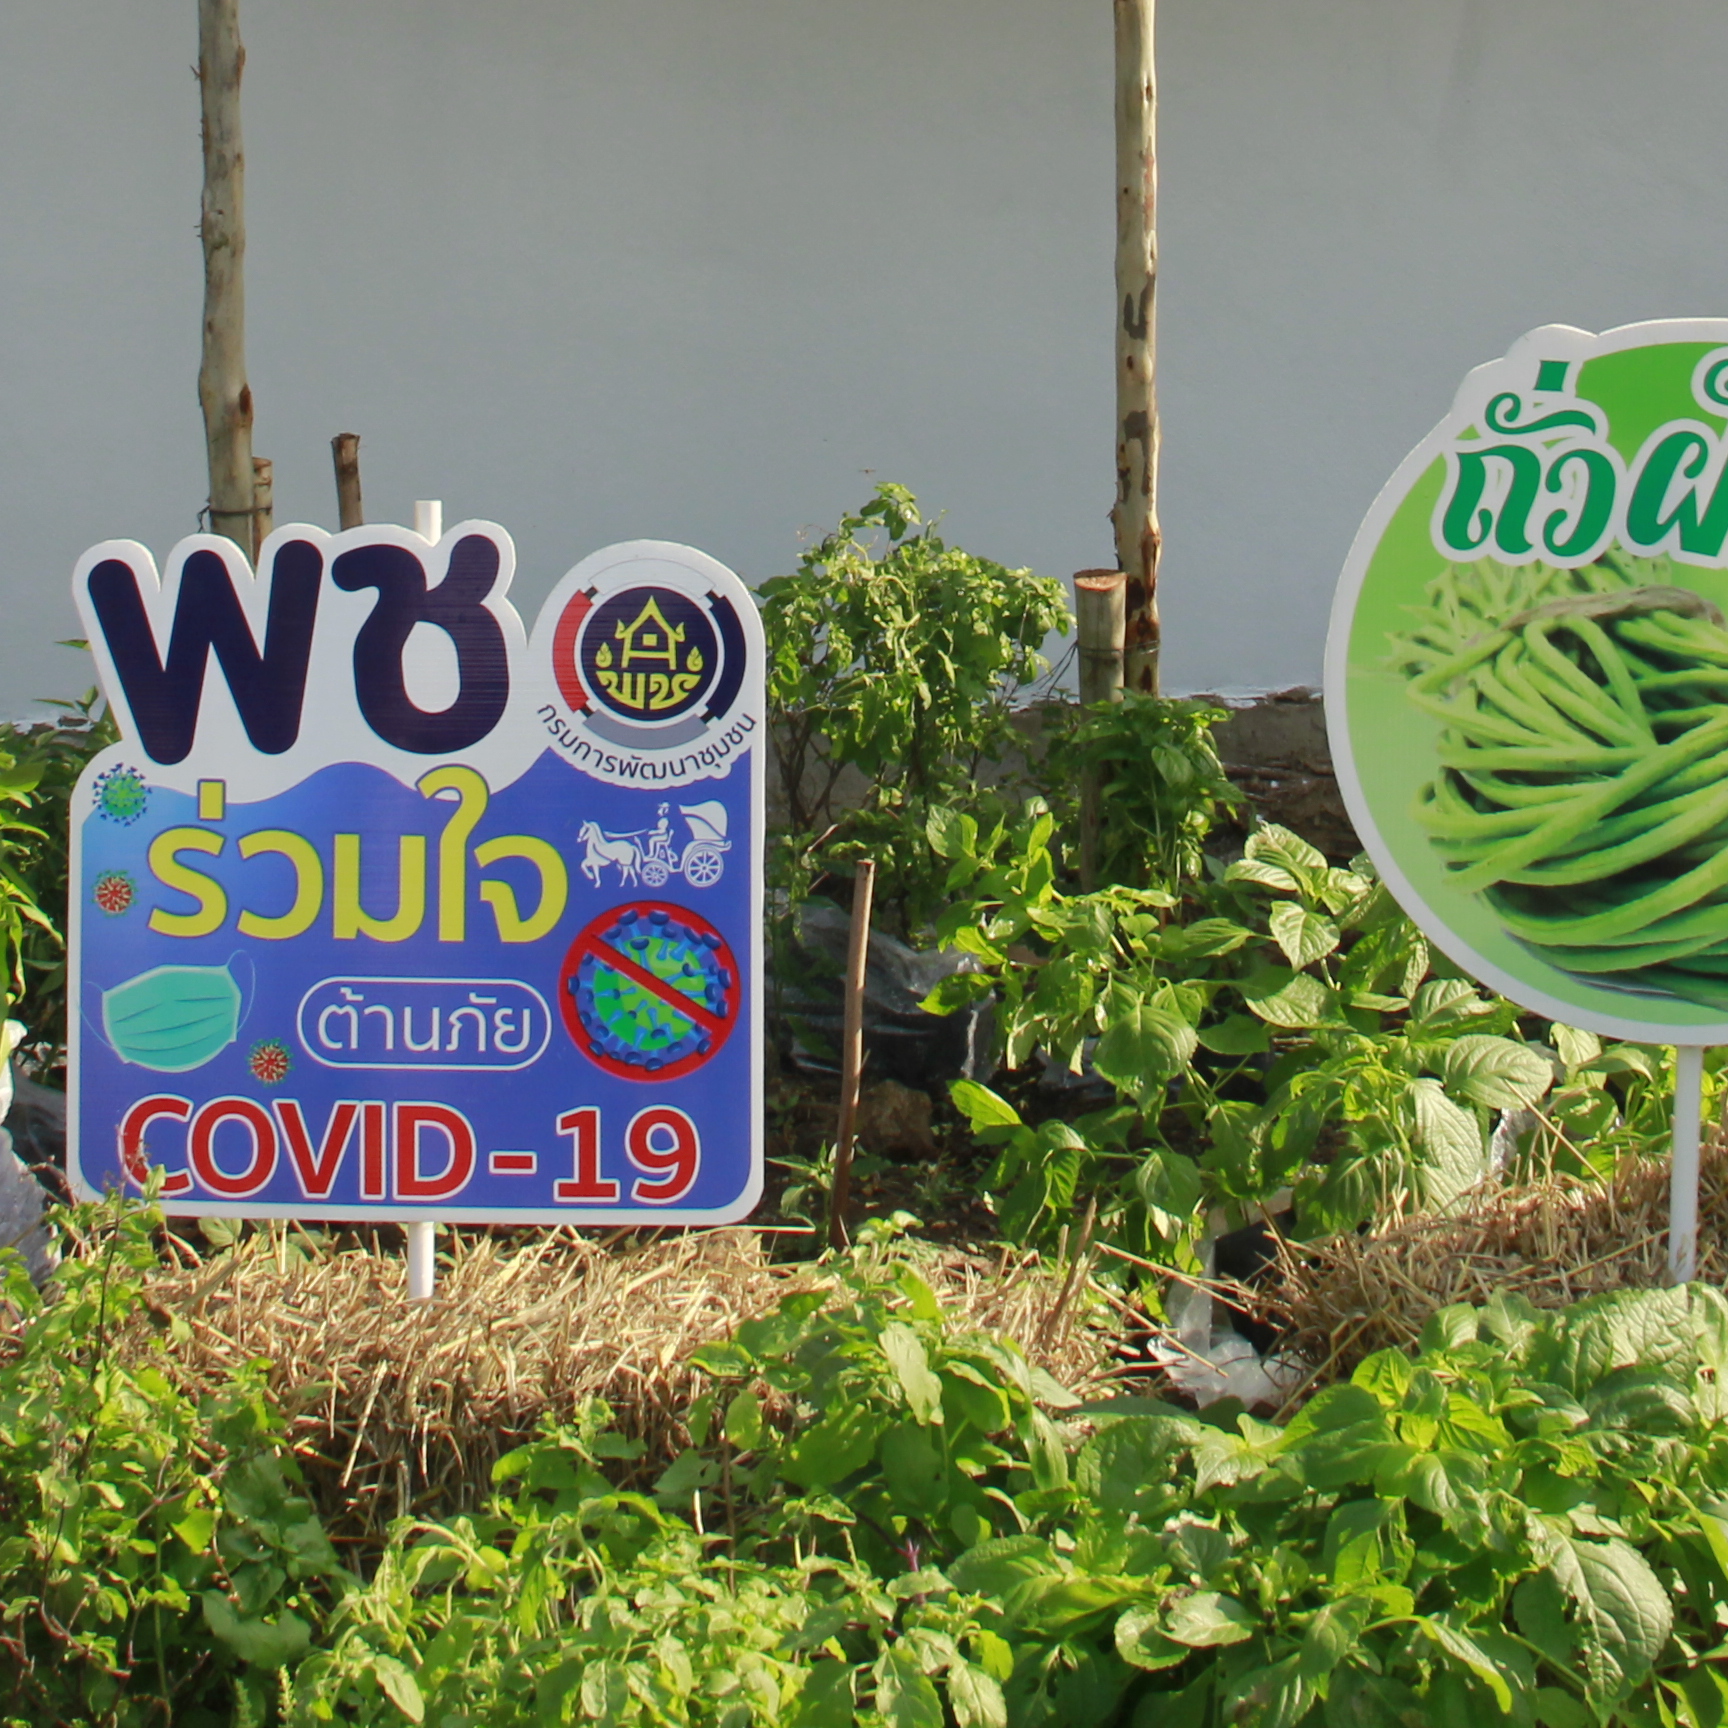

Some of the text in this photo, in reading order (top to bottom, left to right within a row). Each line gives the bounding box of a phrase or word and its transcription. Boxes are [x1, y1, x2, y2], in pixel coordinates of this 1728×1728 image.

[88, 533, 510, 765] พช
[537, 704, 757, 780] กรมการพัฒนาชุมชน
[148, 765, 569, 944] ร่วมใจ
[318, 988, 534, 1054] ต้านภัย
